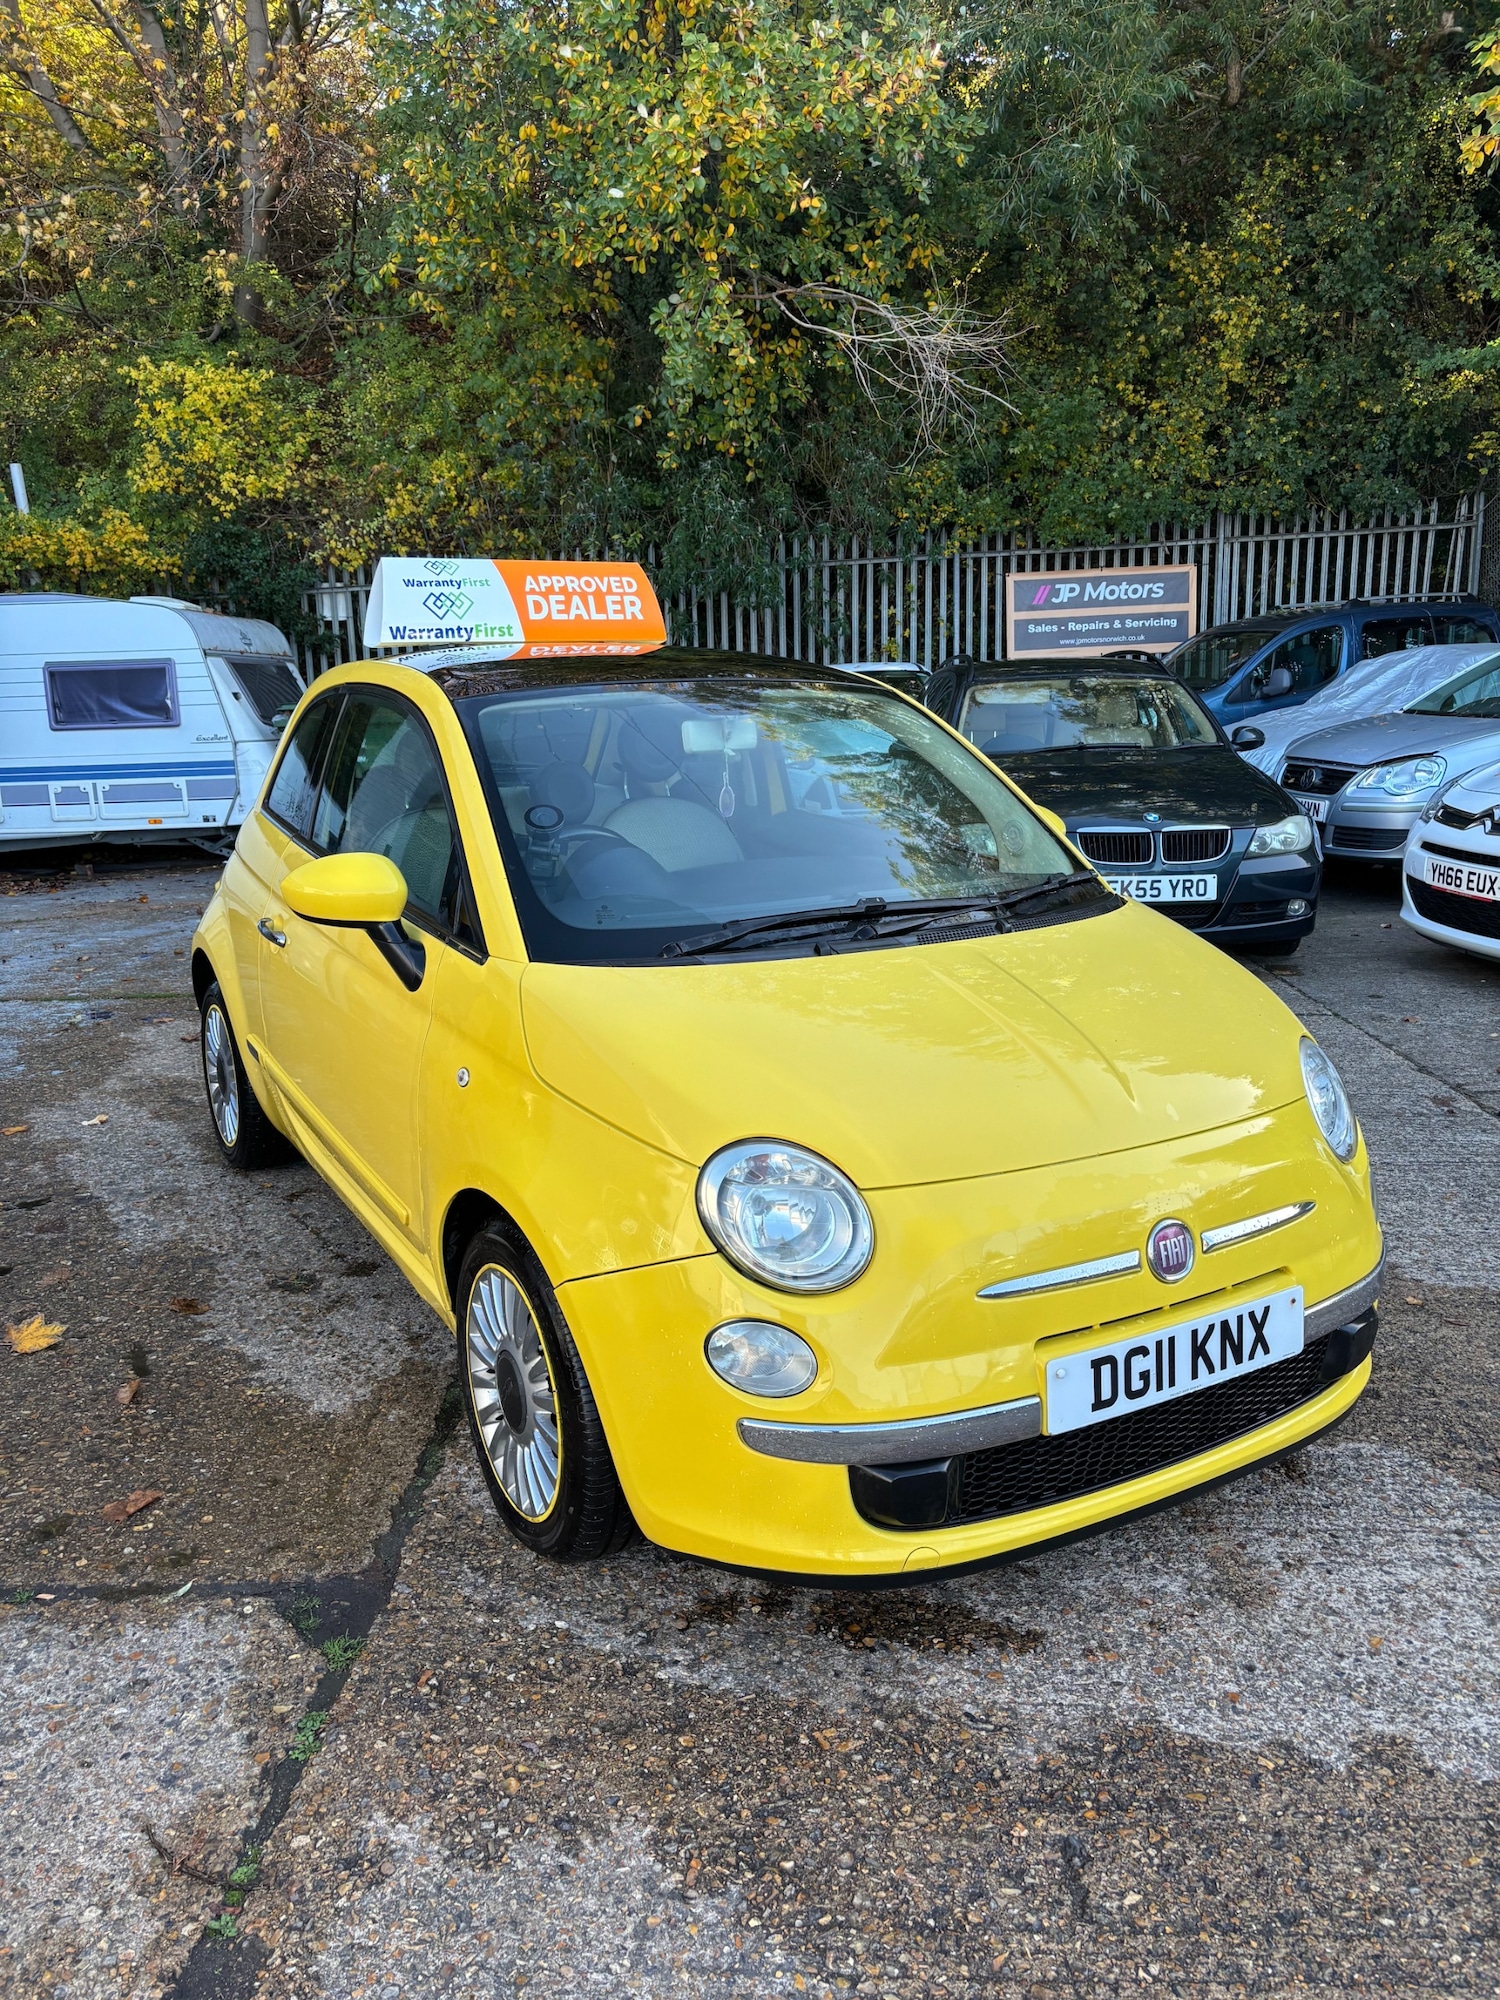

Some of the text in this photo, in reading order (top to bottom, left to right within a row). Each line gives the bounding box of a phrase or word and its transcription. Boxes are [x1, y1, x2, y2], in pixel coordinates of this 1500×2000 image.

[403, 578, 489, 589] WarrantyFirst
[525, 575, 638, 594] APPROVED
[1051, 581, 1165, 603] JP Motors
[528, 595, 644, 620] DEALER
[389, 622, 514, 642] WarrantyFirst
[1028, 624, 1058, 634] Sales
[1068, 620, 1110, 632] Repairs
[1113, 619, 1122, 629] &
[1125, 617, 1178, 628] Servicing
[1168, 878, 1208, 898] YRO
[1431, 862, 1498, 896] YH66 EUX
[1158, 1234, 1186, 1268] FIAT
[1090, 1305, 1271, 1412] DG11 KNX
